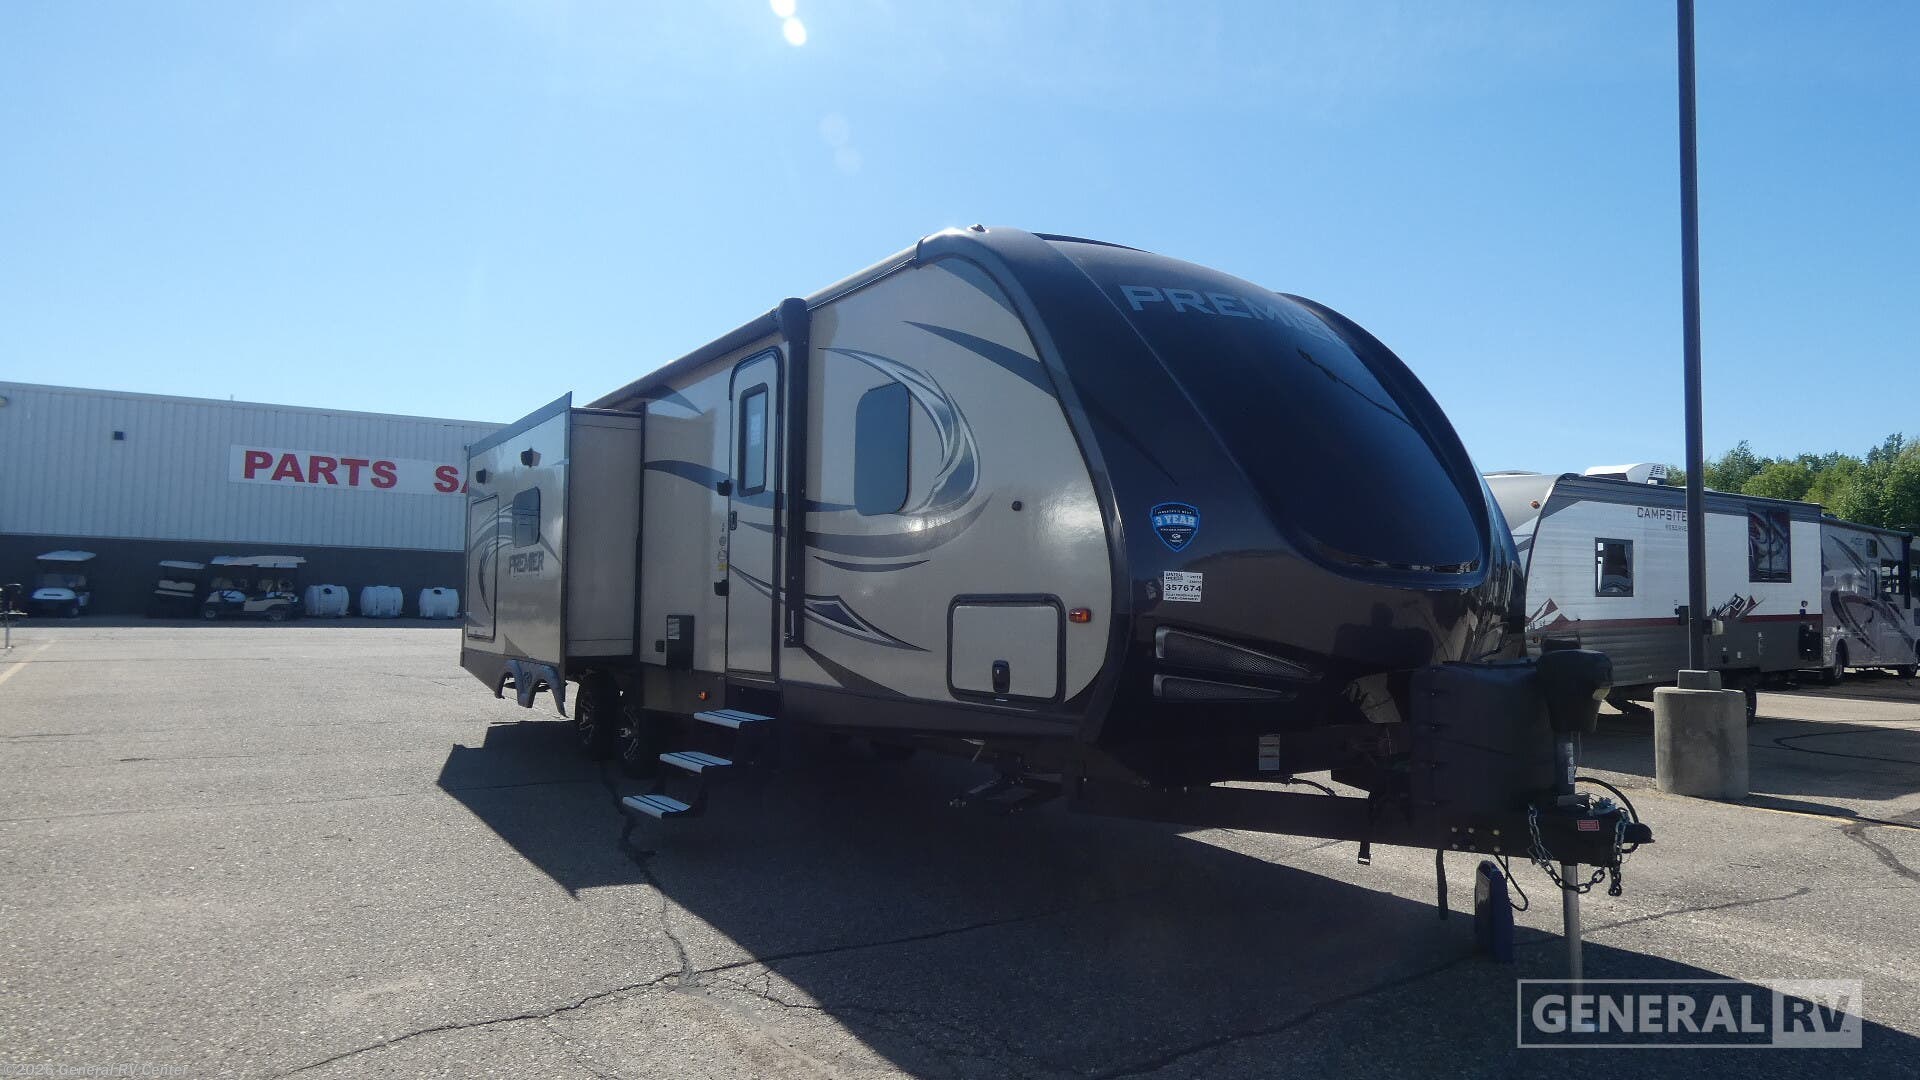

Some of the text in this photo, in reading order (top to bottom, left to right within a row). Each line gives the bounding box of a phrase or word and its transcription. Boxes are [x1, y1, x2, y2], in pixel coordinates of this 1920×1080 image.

[244, 450, 467, 494] PARTS S
[1155, 514, 1195, 527] 3 YEAR
[1637, 506, 1687, 522] CAMPSITE
[508, 551, 544, 575] PREMIER
[1164, 583, 1201, 593] 357674
